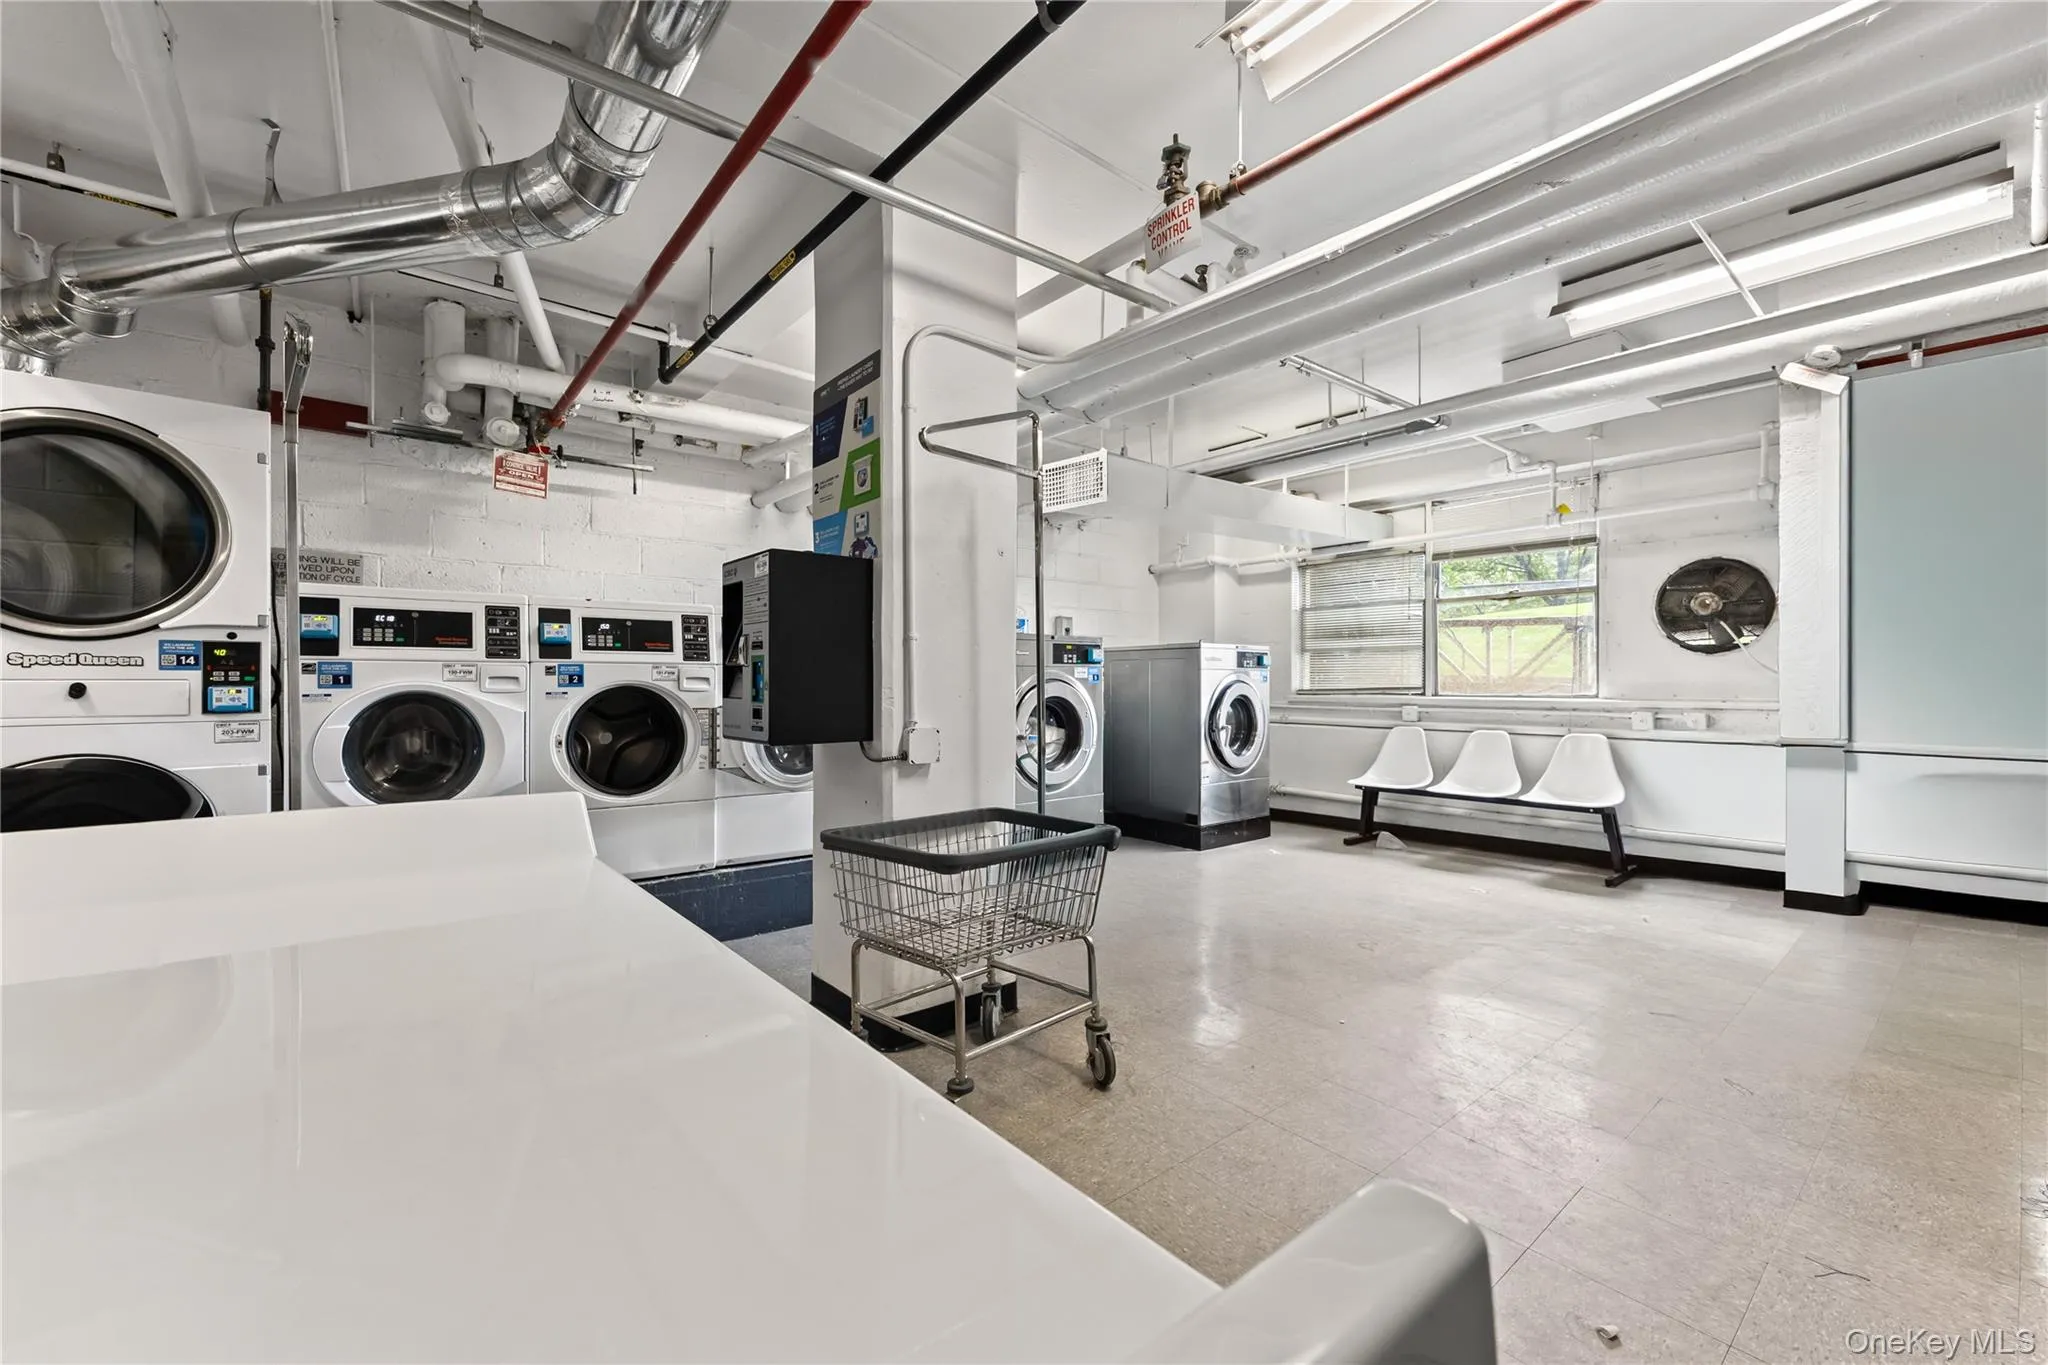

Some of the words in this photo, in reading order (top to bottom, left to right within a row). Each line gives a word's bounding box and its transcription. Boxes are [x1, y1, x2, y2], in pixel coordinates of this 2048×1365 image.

[1147, 197, 1195, 237] SPRINKLER
[1151, 217, 1192, 251] CONTROL
[320, 556, 344, 566] WILL
[347, 559, 361, 567] BE
[326, 566, 355, 575] UPON
[333, 575, 361, 584] CYCLE
[180, 656, 196, 665] 14
[338, 676, 344, 684] 1
[572, 675, 578, 683] 2
